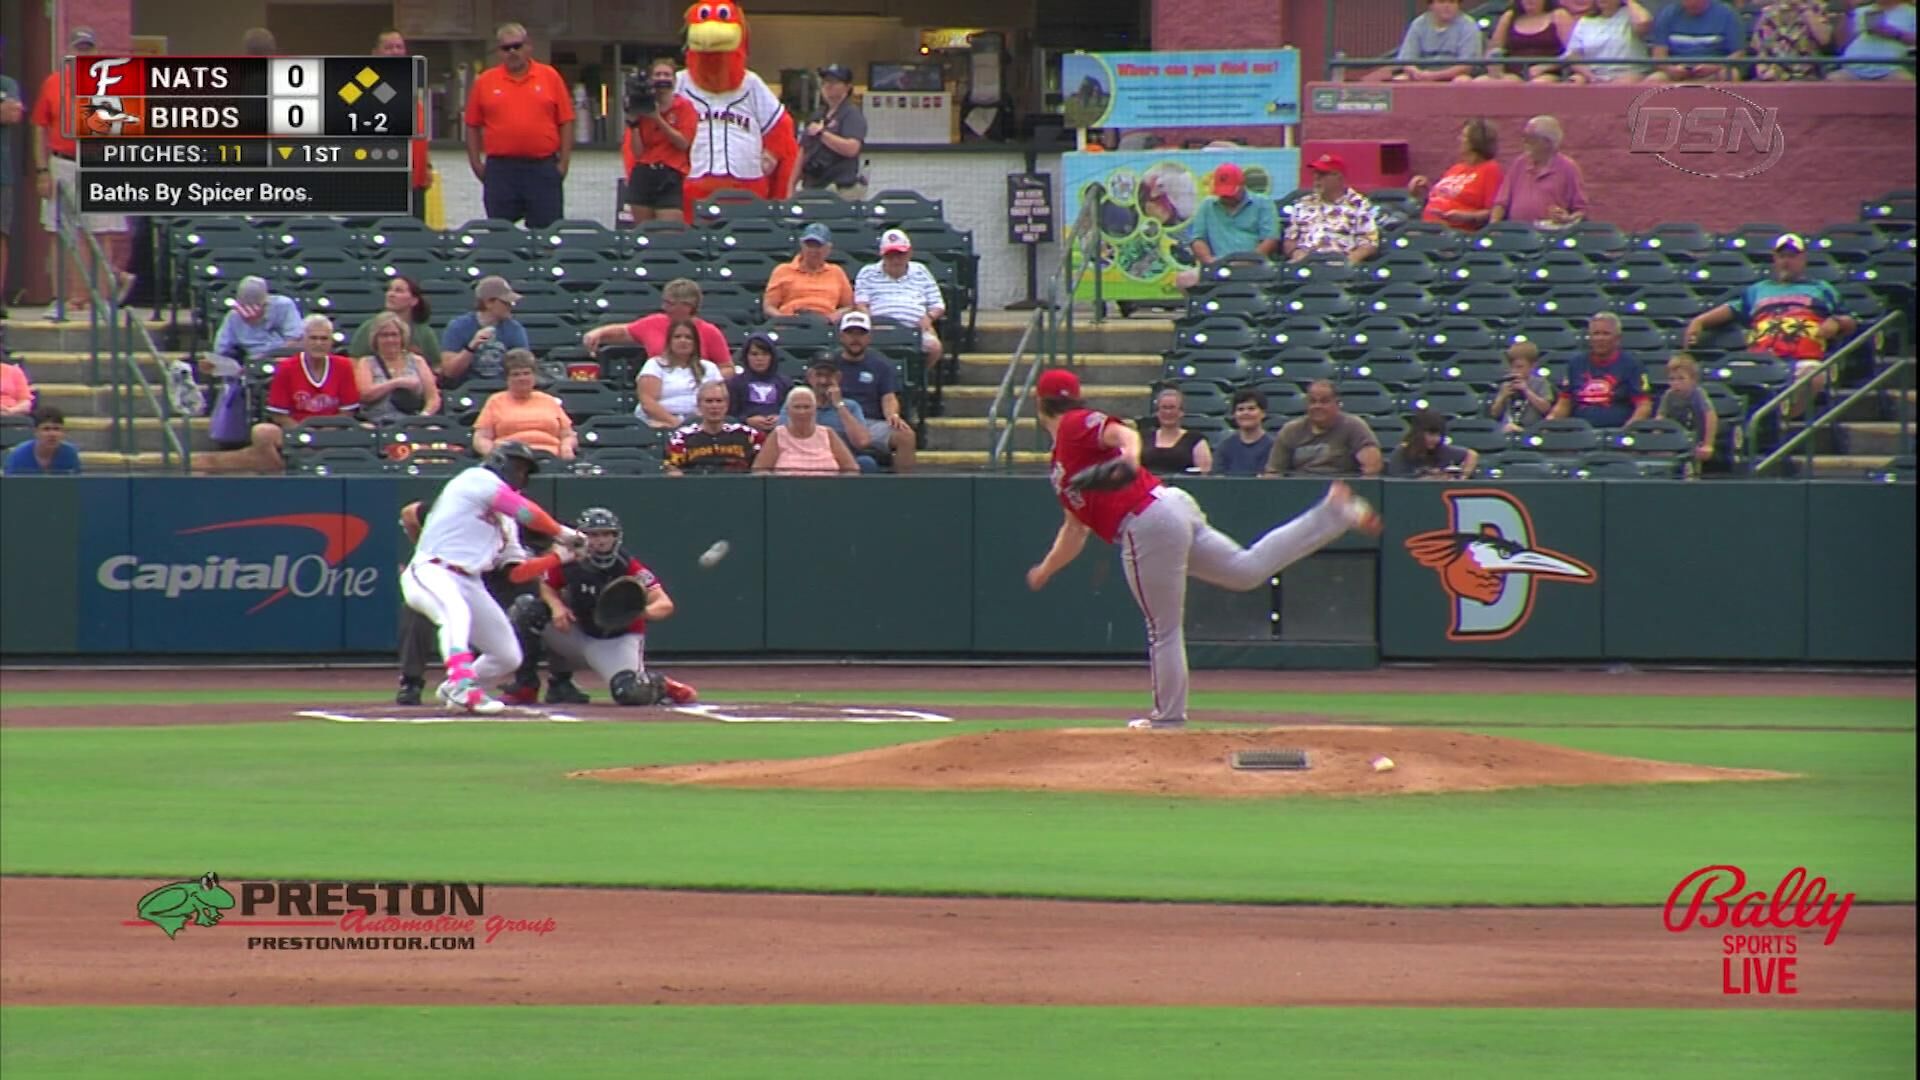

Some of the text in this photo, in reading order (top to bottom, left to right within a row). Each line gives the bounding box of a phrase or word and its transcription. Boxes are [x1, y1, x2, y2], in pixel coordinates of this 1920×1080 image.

[1117, 63, 1160, 77] Where
[1164, 64, 1188, 76] can
[1192, 63, 1216, 78] you
[1220, 61, 1248, 75] find
